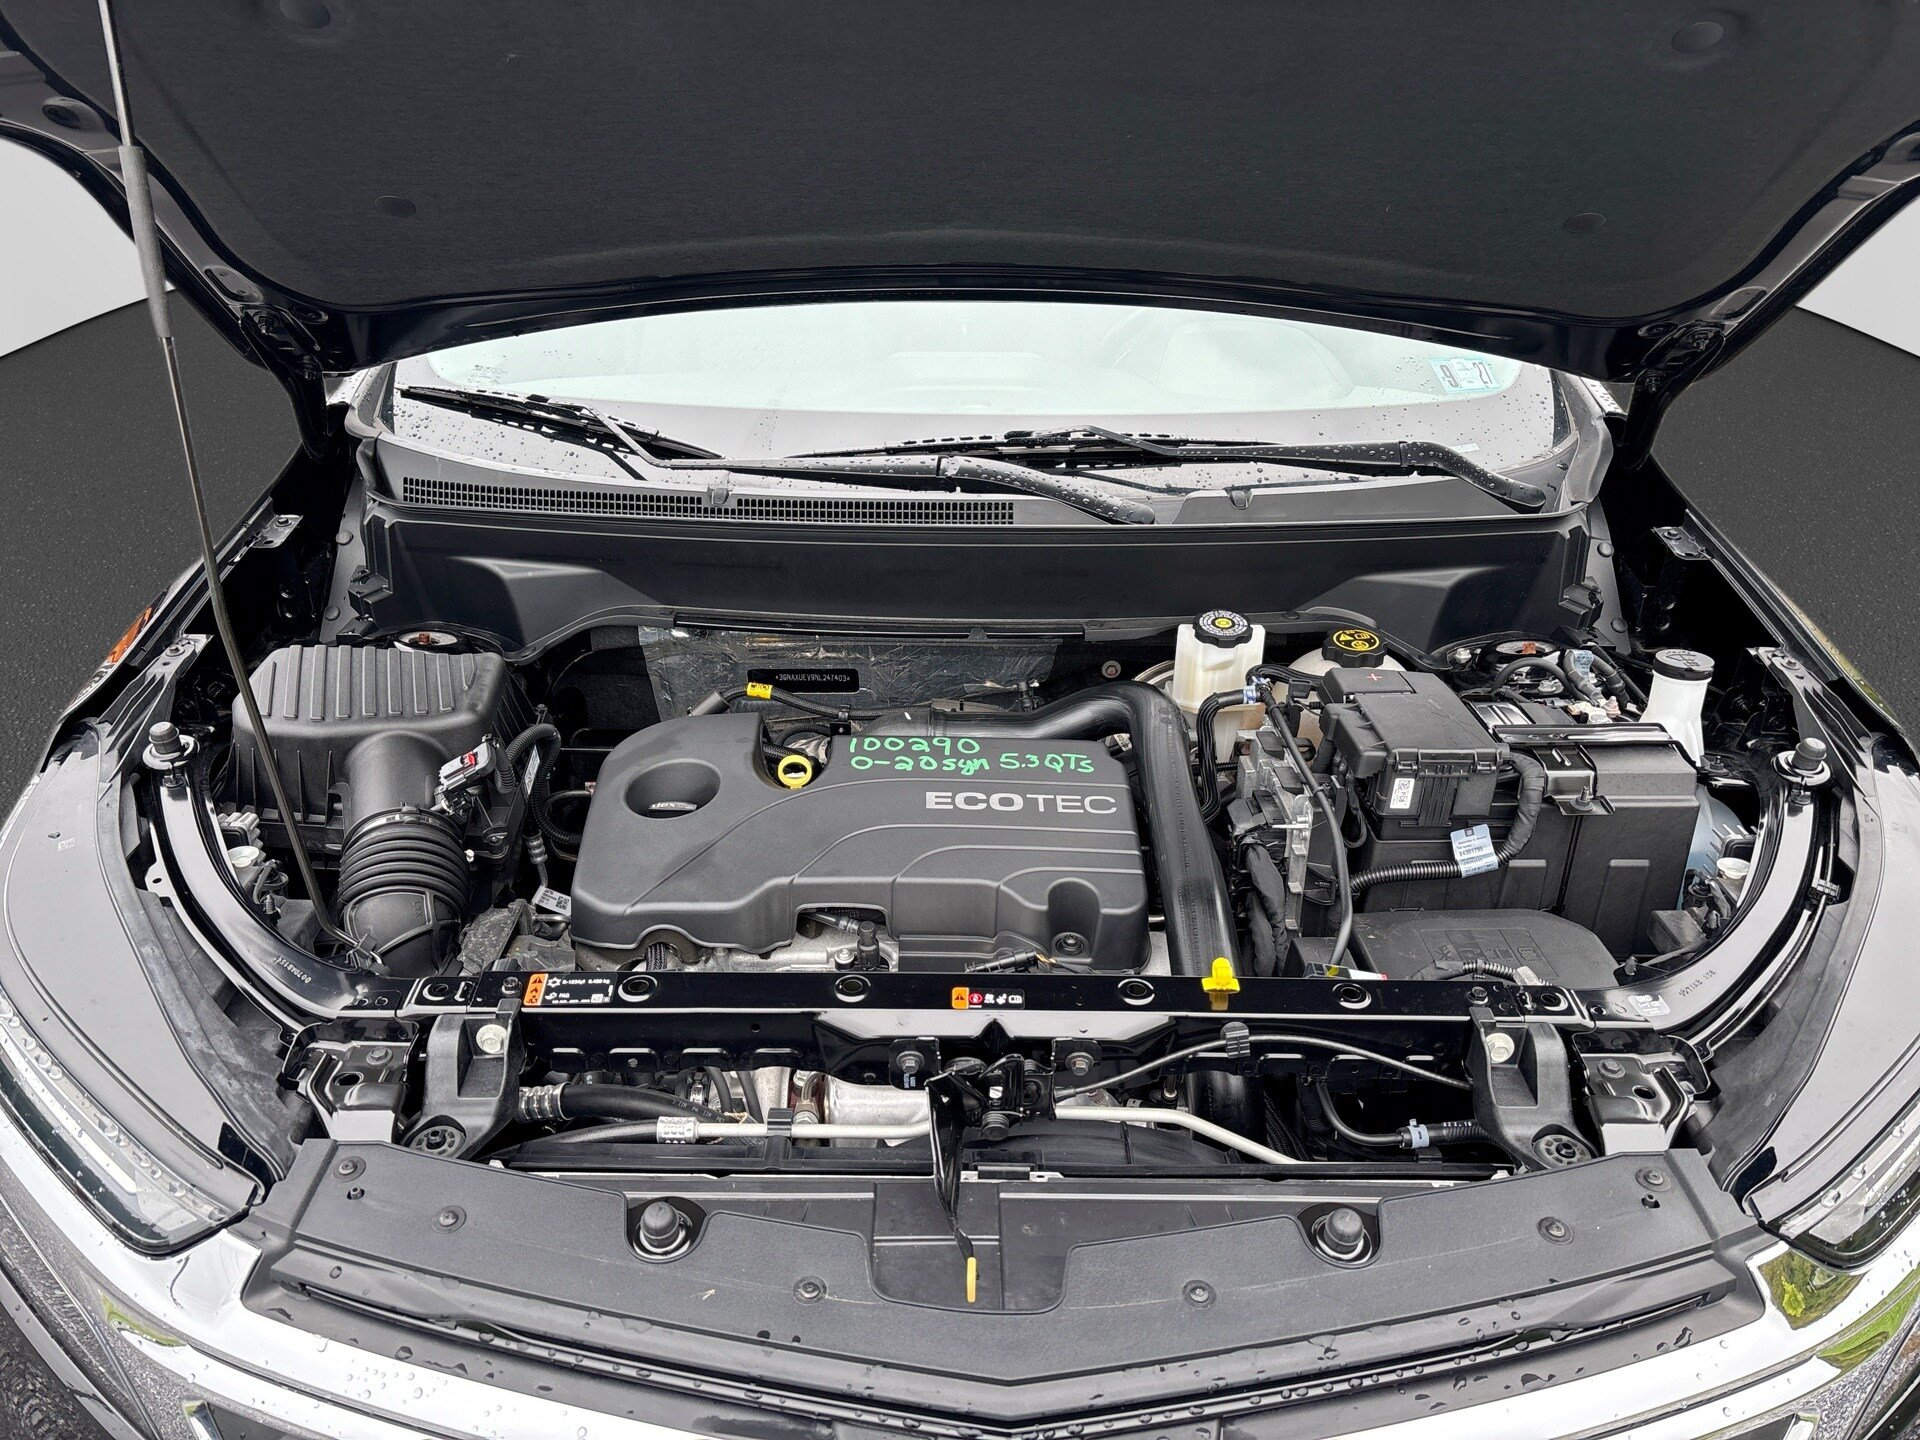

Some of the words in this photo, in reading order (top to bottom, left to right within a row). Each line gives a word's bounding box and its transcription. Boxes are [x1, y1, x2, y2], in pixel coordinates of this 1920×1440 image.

[1439, 364, 1460, 388] 9
[849, 737, 981, 756] 100290
[925, 791, 1118, 815] ECOTEC
